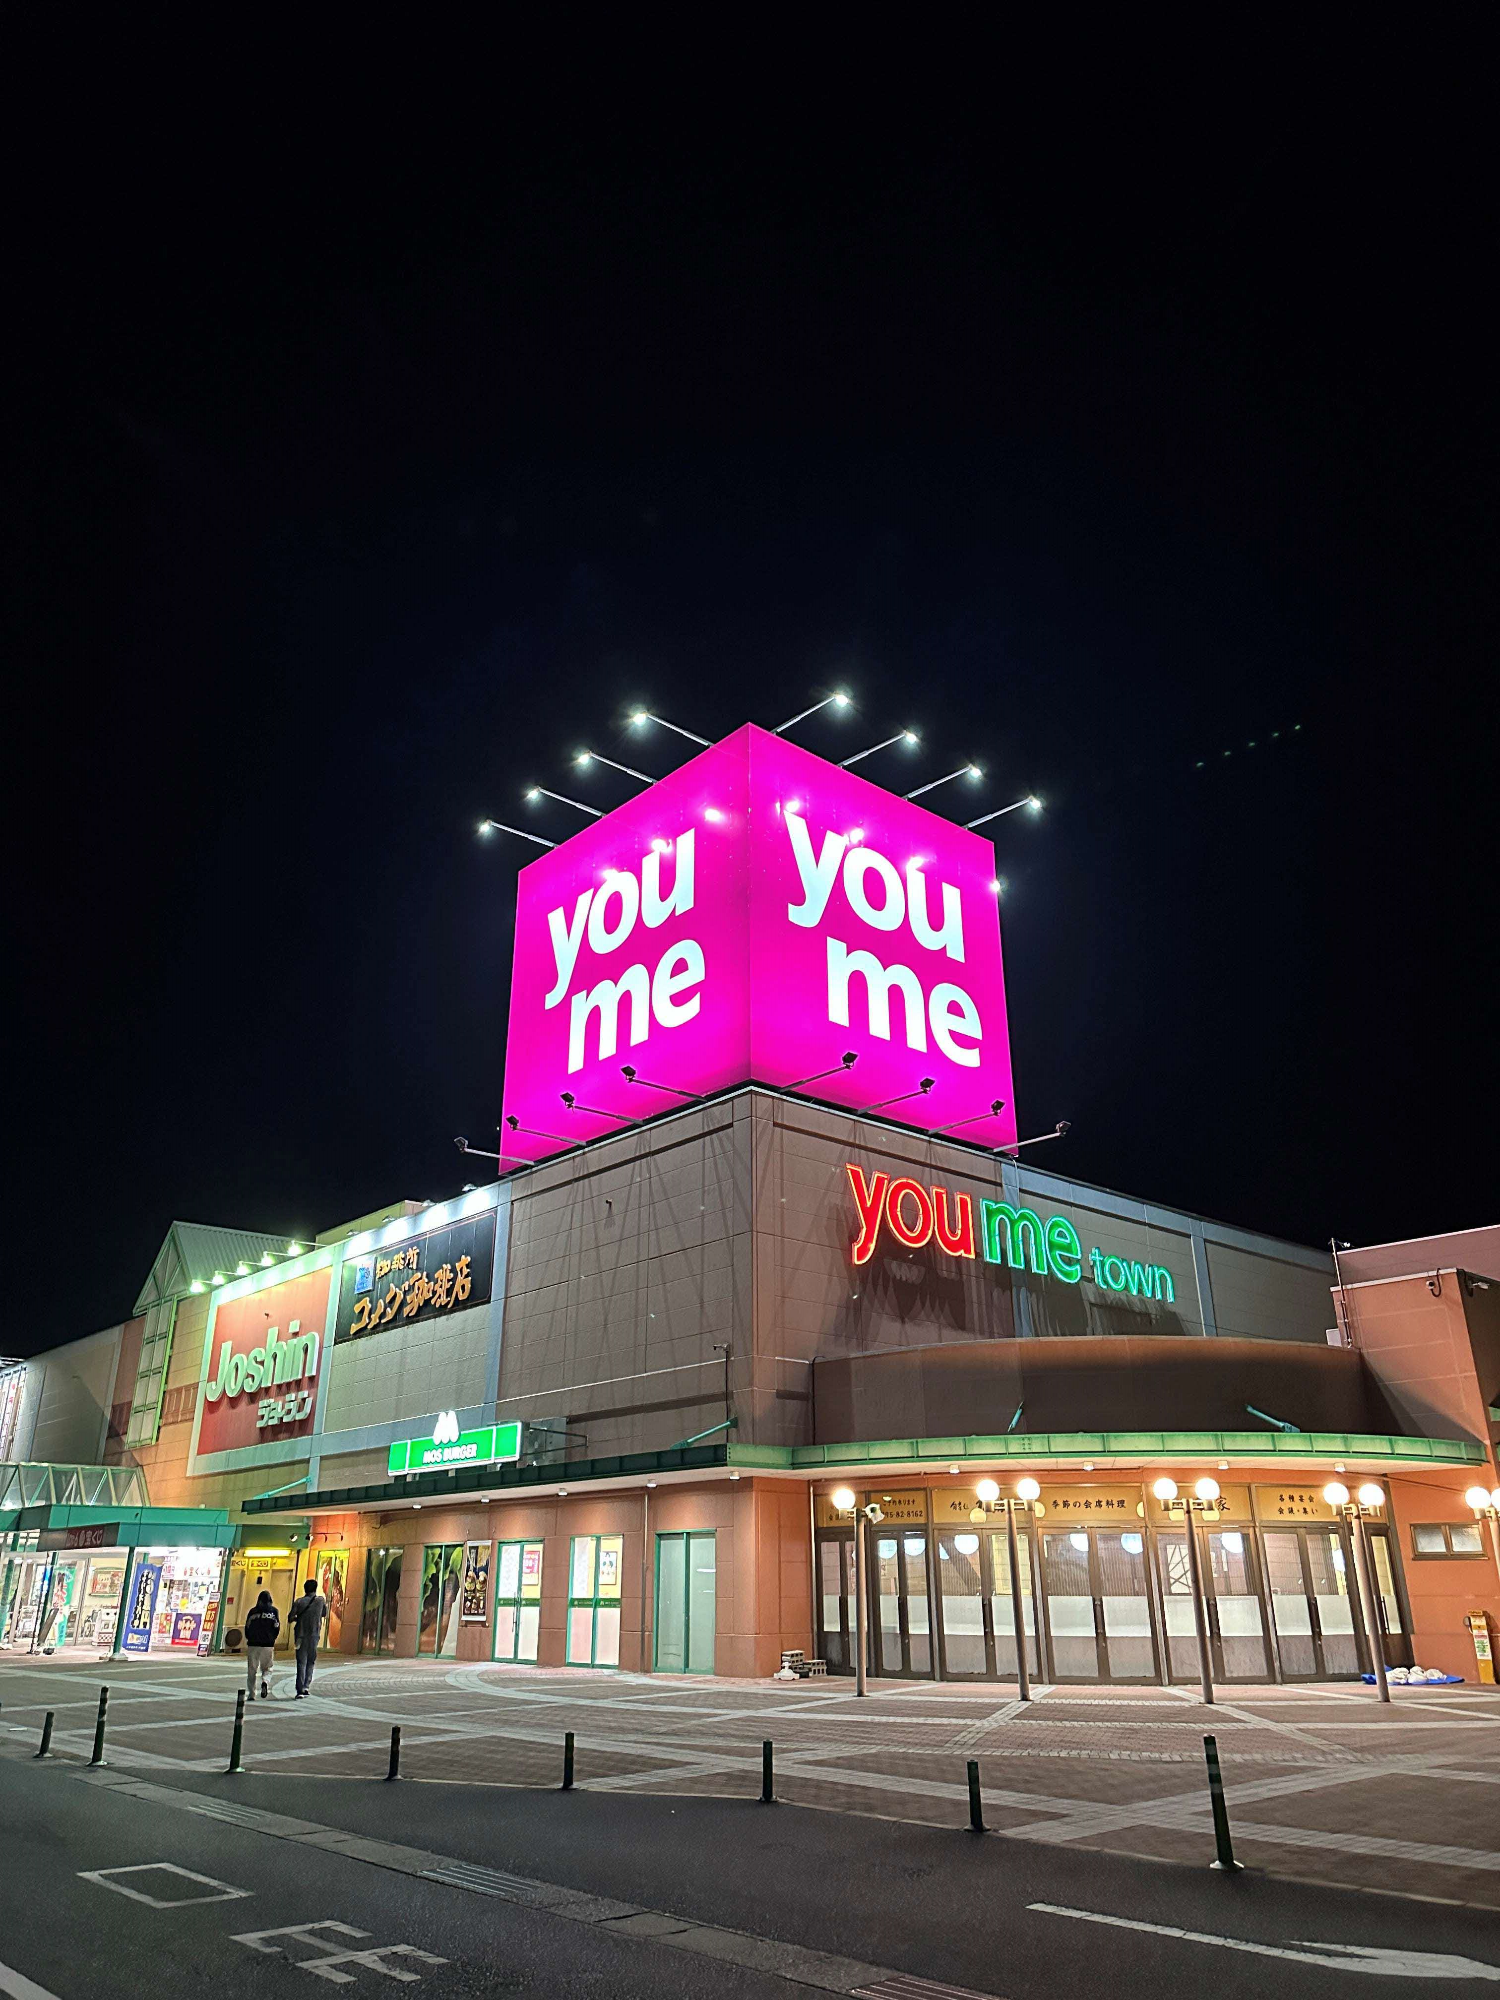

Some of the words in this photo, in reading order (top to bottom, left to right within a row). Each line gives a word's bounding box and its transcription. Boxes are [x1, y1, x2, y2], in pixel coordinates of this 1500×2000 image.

[544, 827, 696, 1010] you
[783, 810, 967, 964] you
[567, 938, 706, 1075] me
[827, 936, 983, 1068] me
[350, 1254, 472, 1335] コメダ珈琲店
[1089, 1247, 1175, 1304] town
[205, 1319, 320, 1402] Joshin
[256, 1390, 313, 1428] ジョーシン
[422, 1448, 442, 1464] MOS
[443, 1444, 477, 1461] BURGER
[1051, 1499, 1127, 1509] 季節の会席料理
